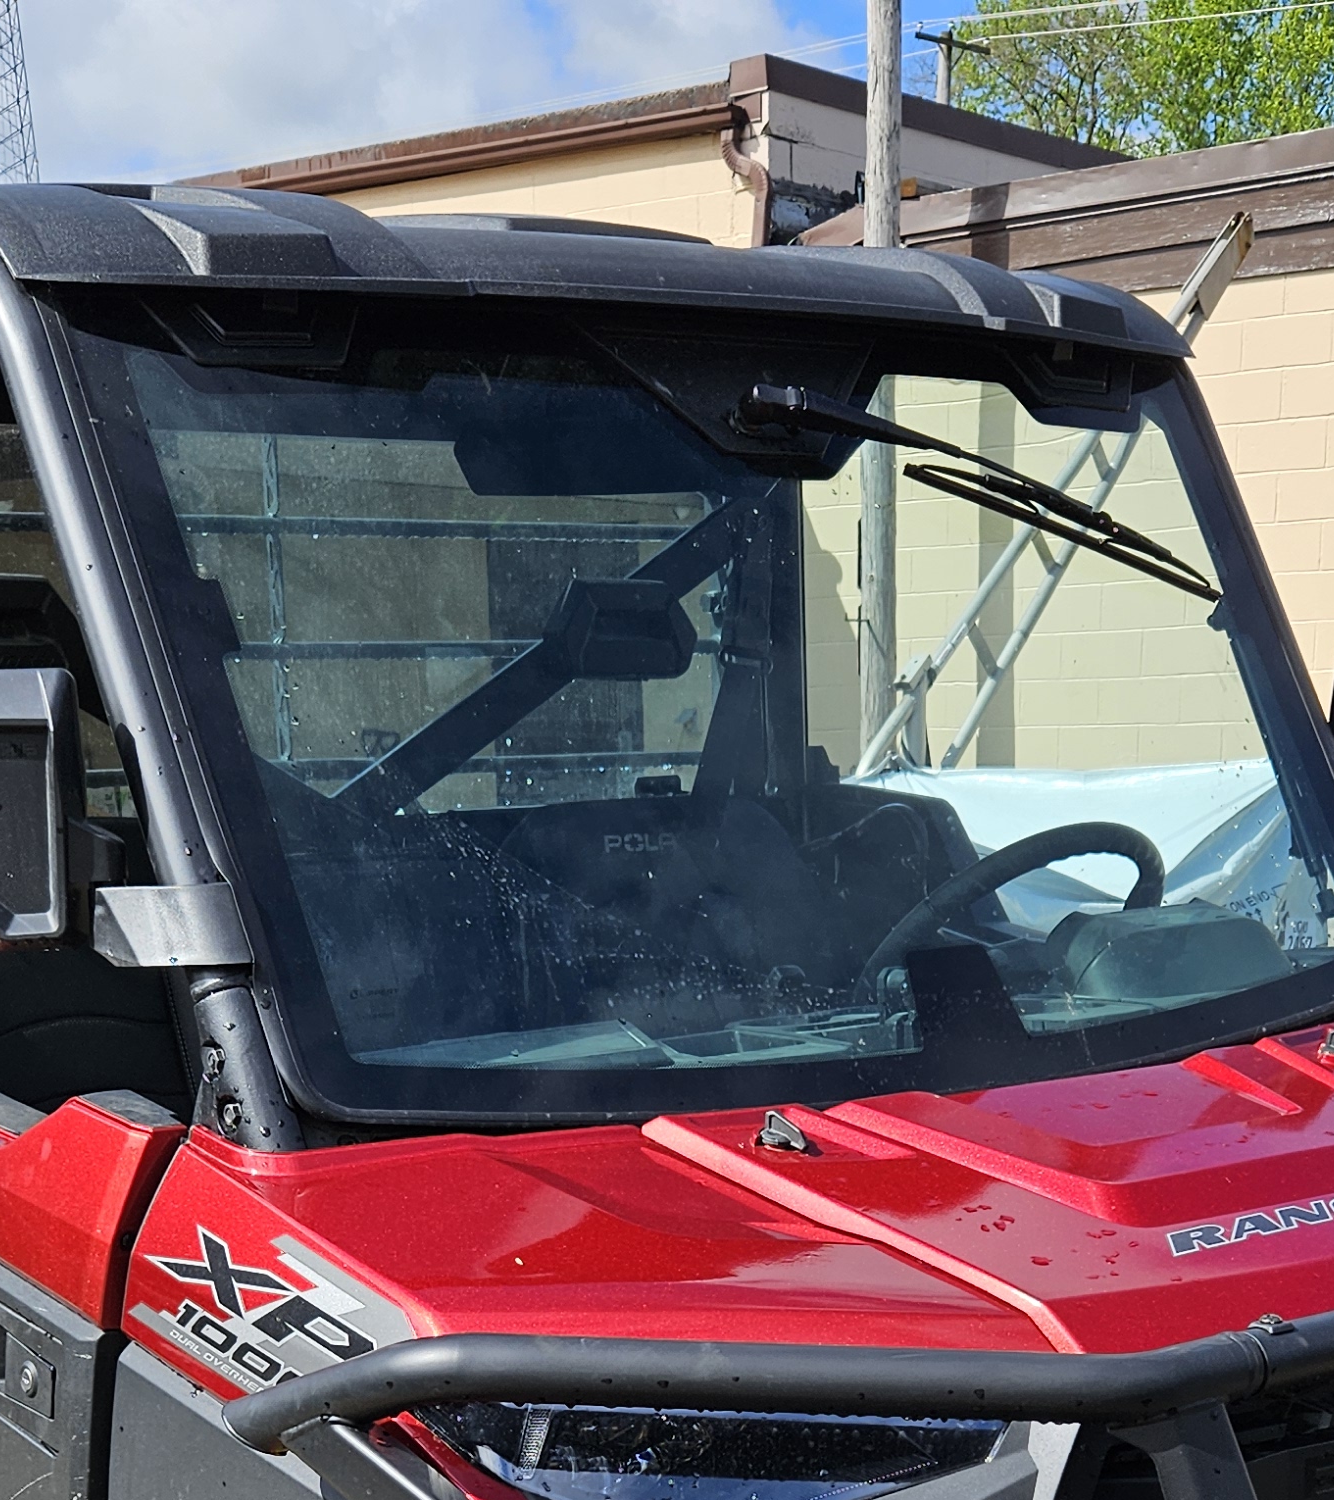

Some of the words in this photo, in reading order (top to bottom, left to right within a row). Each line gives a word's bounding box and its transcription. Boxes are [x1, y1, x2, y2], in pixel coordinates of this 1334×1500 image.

[143, 1223, 378, 1363] XP
[169, 1329, 203, 1357] DUAL
[174, 1299, 304, 1386] 100
